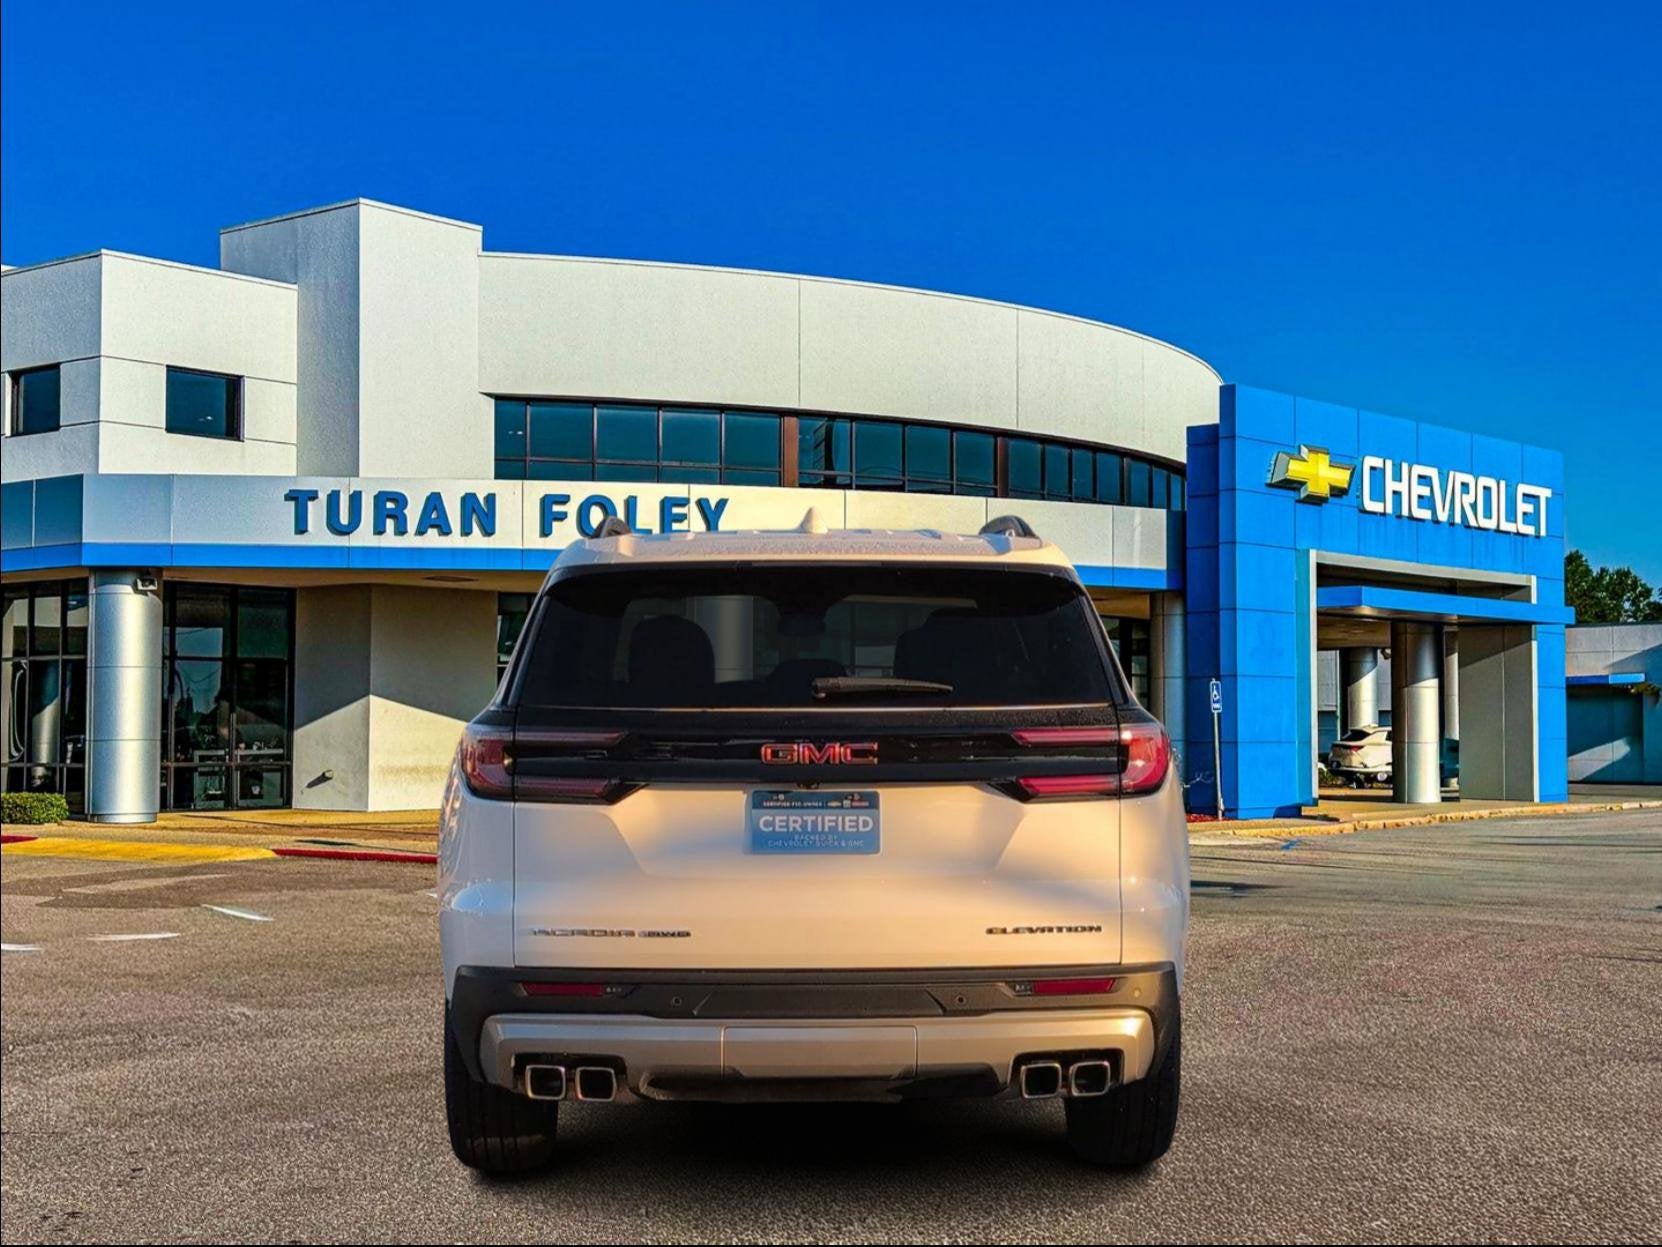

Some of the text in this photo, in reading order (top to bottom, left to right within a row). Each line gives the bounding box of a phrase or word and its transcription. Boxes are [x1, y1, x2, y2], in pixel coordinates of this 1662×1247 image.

[1360, 455, 1552, 537] CHEVROLET
[284, 489, 729, 538] TURAN FOLEY
[761, 742, 878, 764] GMC
[759, 815, 874, 832] CERTIFIED
[985, 925, 1102, 935] ELEVATION
